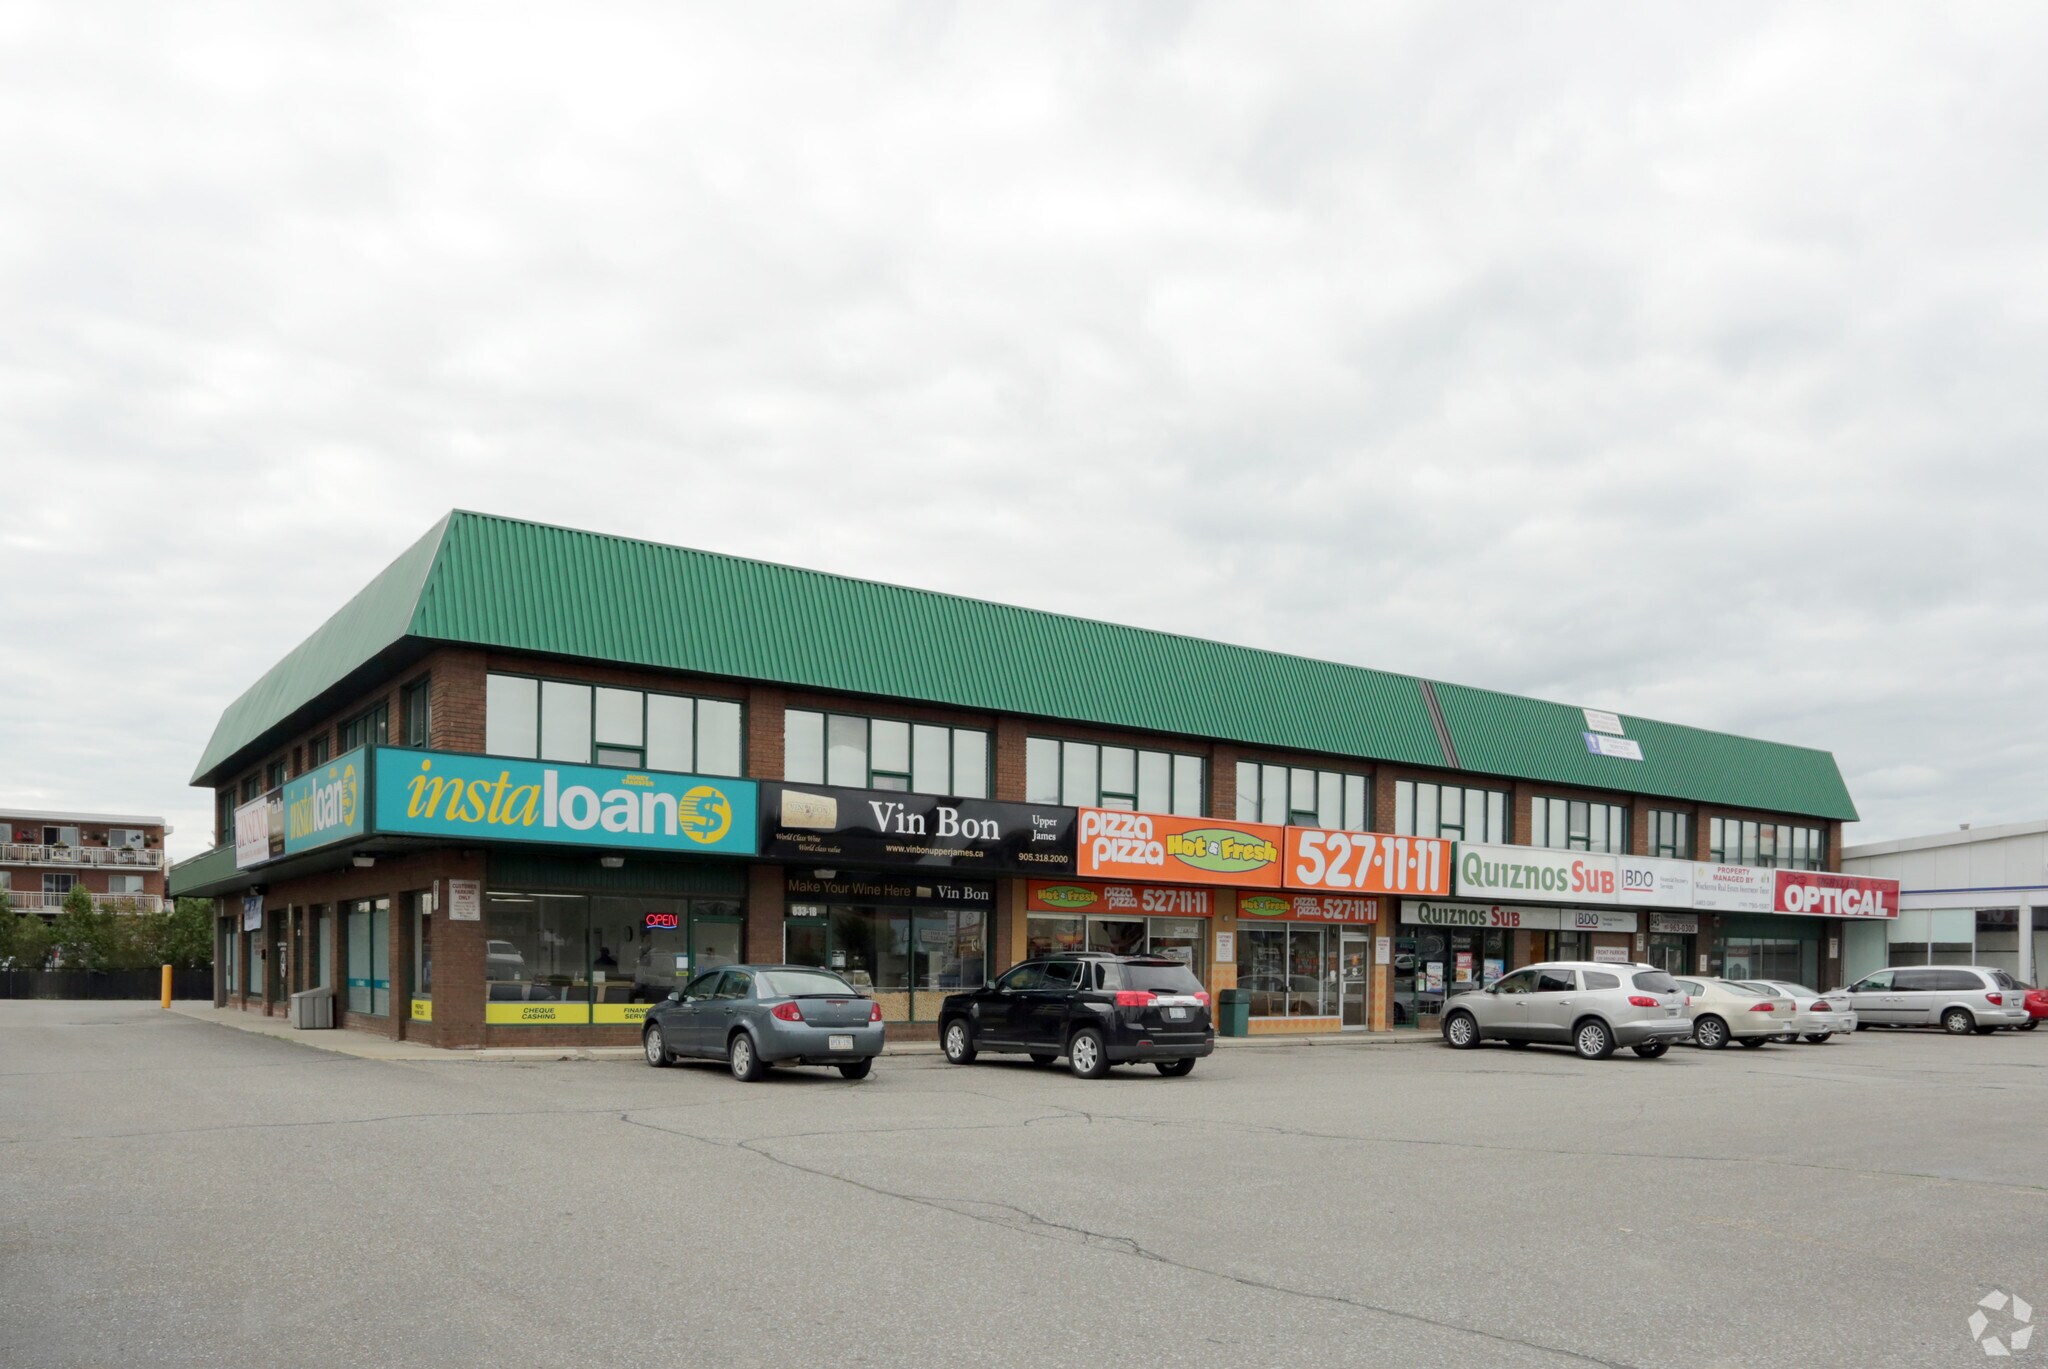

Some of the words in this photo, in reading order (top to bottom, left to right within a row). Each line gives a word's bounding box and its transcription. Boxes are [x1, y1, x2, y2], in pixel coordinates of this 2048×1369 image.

[868, 800, 926, 836] Vin
[935, 806, 1000, 840] Bon
[1032, 815, 1057, 828] Upper
[1081, 811, 1153, 844] pizza
[1032, 830, 1057, 841] James
[885, 844, 984, 858] www.vinbonupperjames.ca
[1092, 837, 1164, 870] pizza
[1166, 834, 1206, 857] Hot
[1208, 841, 1219, 855] &
[1220, 837, 1278, 863] Fresh
[1018, 852, 1068, 863] 905.318.2000
[1717, 866, 1750, 875] PROPERTY
[1626, 869, 1653, 887] BDO
[1713, 874, 1744, 883] MANAGED
[788, 880, 821, 893] Make
[822, 881, 849, 894] Your
[852, 883, 880, 895] Wine
[885, 884, 911, 897] Here
[937, 885, 959, 899] Vin
[963, 886, 989, 900] Bon
[1104, 887, 1133, 900] pizza
[1037, 889, 1059, 900] Hot
[1067, 890, 1098, 902] Fresh
[1784, 884, 1887, 916] OPTICAL
[1109, 897, 1138, 910] pizza
[1241, 900, 1259, 909] Hot
[1265, 901, 1290, 911] Fresh
[1293, 897, 1317, 909] pizza
[1297, 906, 1321, 918] pizza
[1578, 912, 1599, 925] BDO
[646, 914, 678, 926] OPEN
